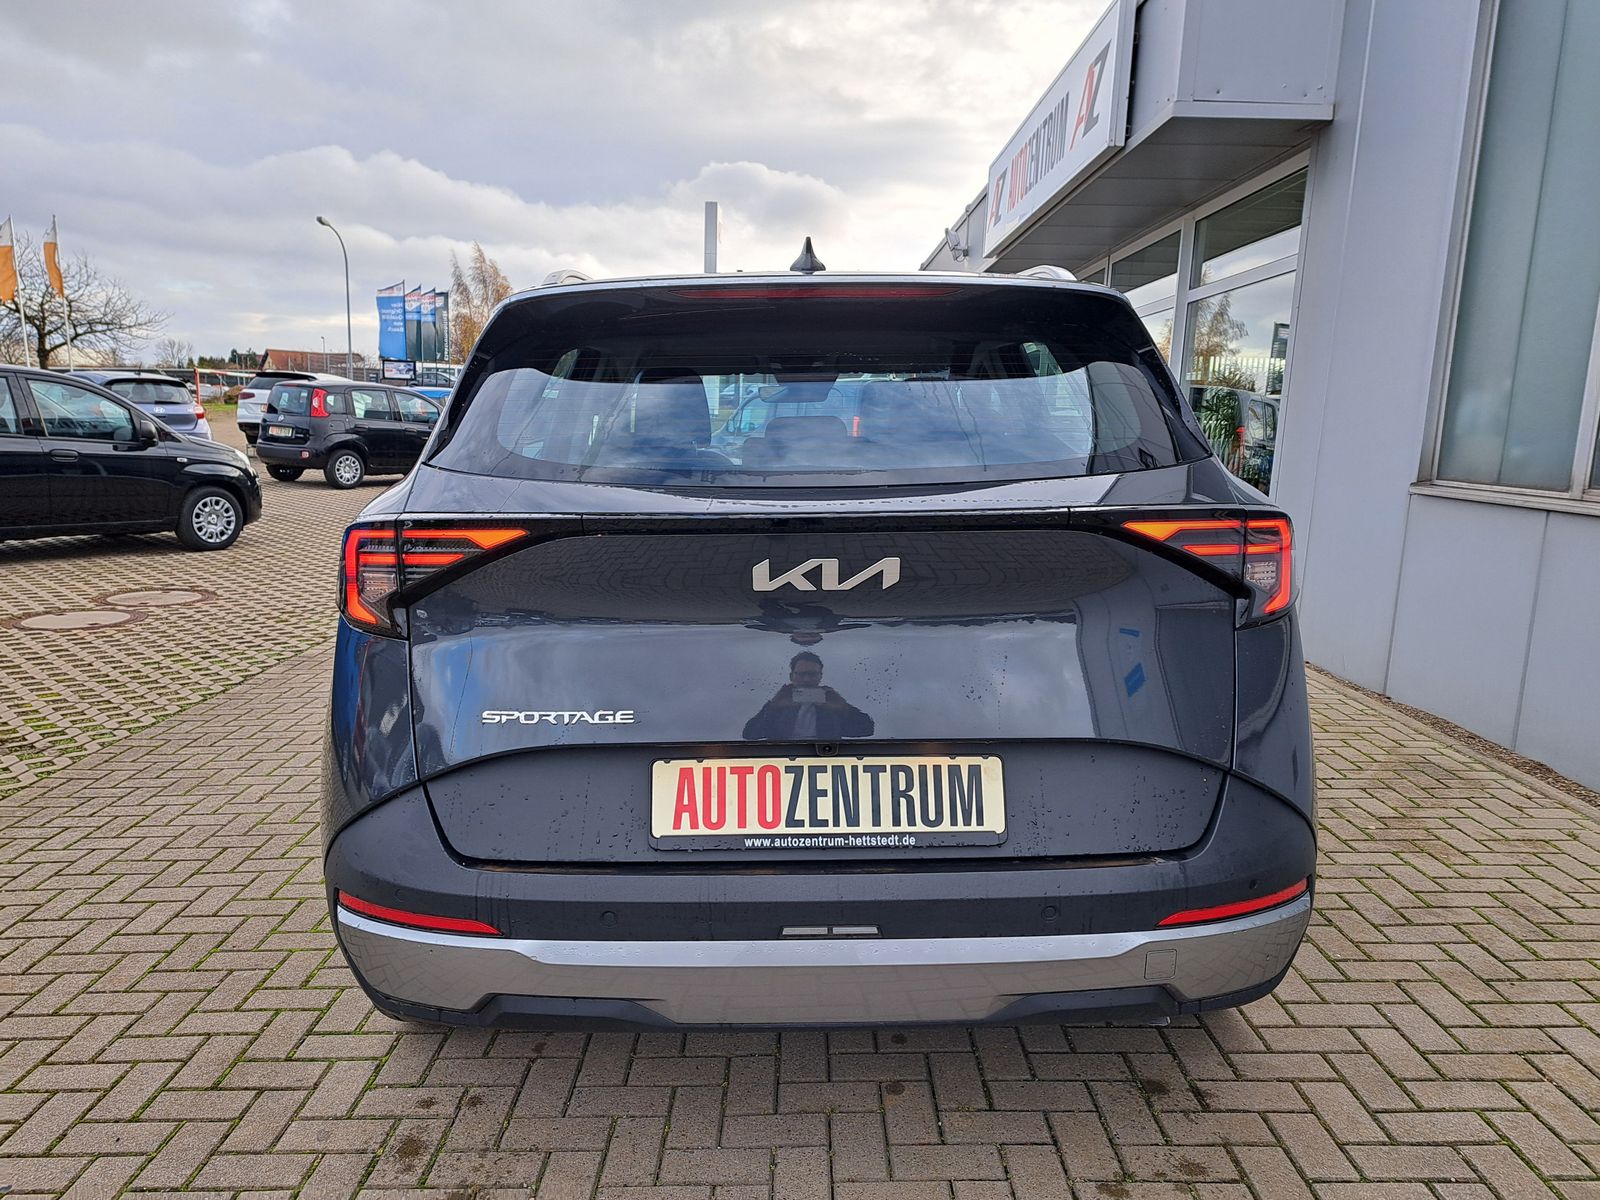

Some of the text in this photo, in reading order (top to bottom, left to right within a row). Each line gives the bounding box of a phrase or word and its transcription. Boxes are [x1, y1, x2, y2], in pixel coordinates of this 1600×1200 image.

[1008, 91, 1069, 213] AUTOZENTRUM
[1070, 39, 1112, 151] AZ
[752, 557, 901, 592] KIA
[481, 710, 635, 725] SPORTAGE
[672, 764, 985, 831] AUTOZENTRUM
[744, 834, 917, 848] www.autozentrum-hettstedt.de
